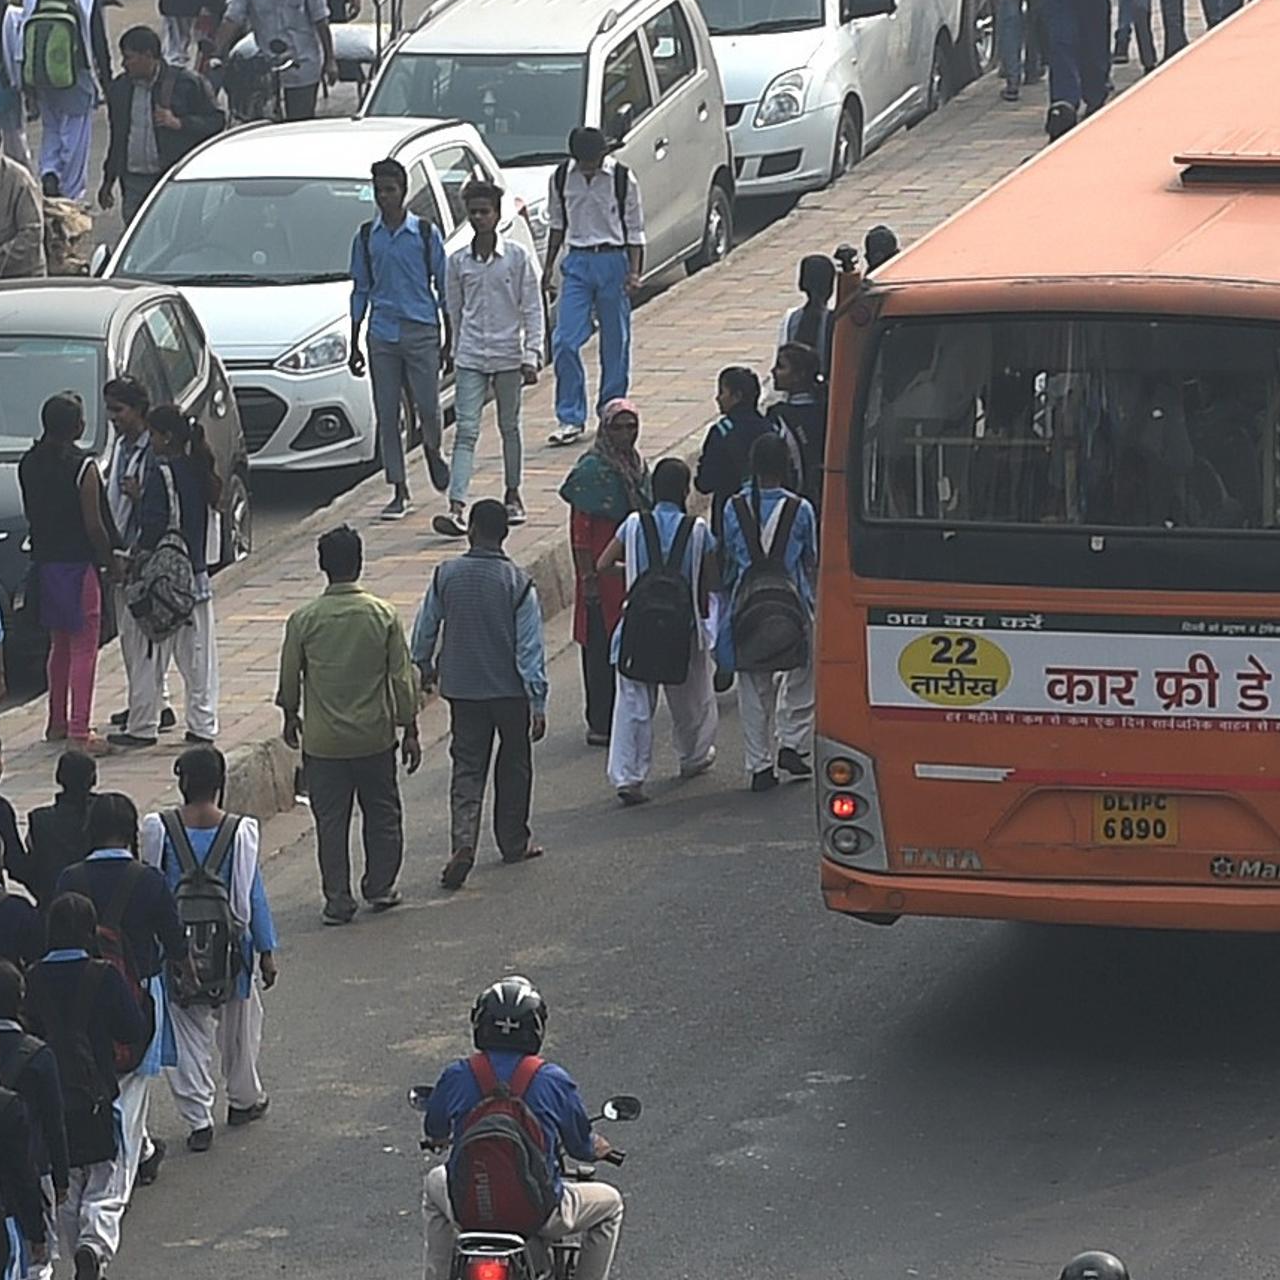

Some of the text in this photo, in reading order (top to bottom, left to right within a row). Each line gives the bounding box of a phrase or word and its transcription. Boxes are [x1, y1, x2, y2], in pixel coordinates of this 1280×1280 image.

[886, 613, 1045, 630] अब बस करें
[930, 636, 978, 666] 22
[910, 668, 998, 697] तारीख
[1045, 653, 1272, 711] कार फ्री डे
[1103, 794, 1167, 811] DL1PC
[1103, 817, 1168, 841] 6890
[900, 848, 984, 871] TATA
